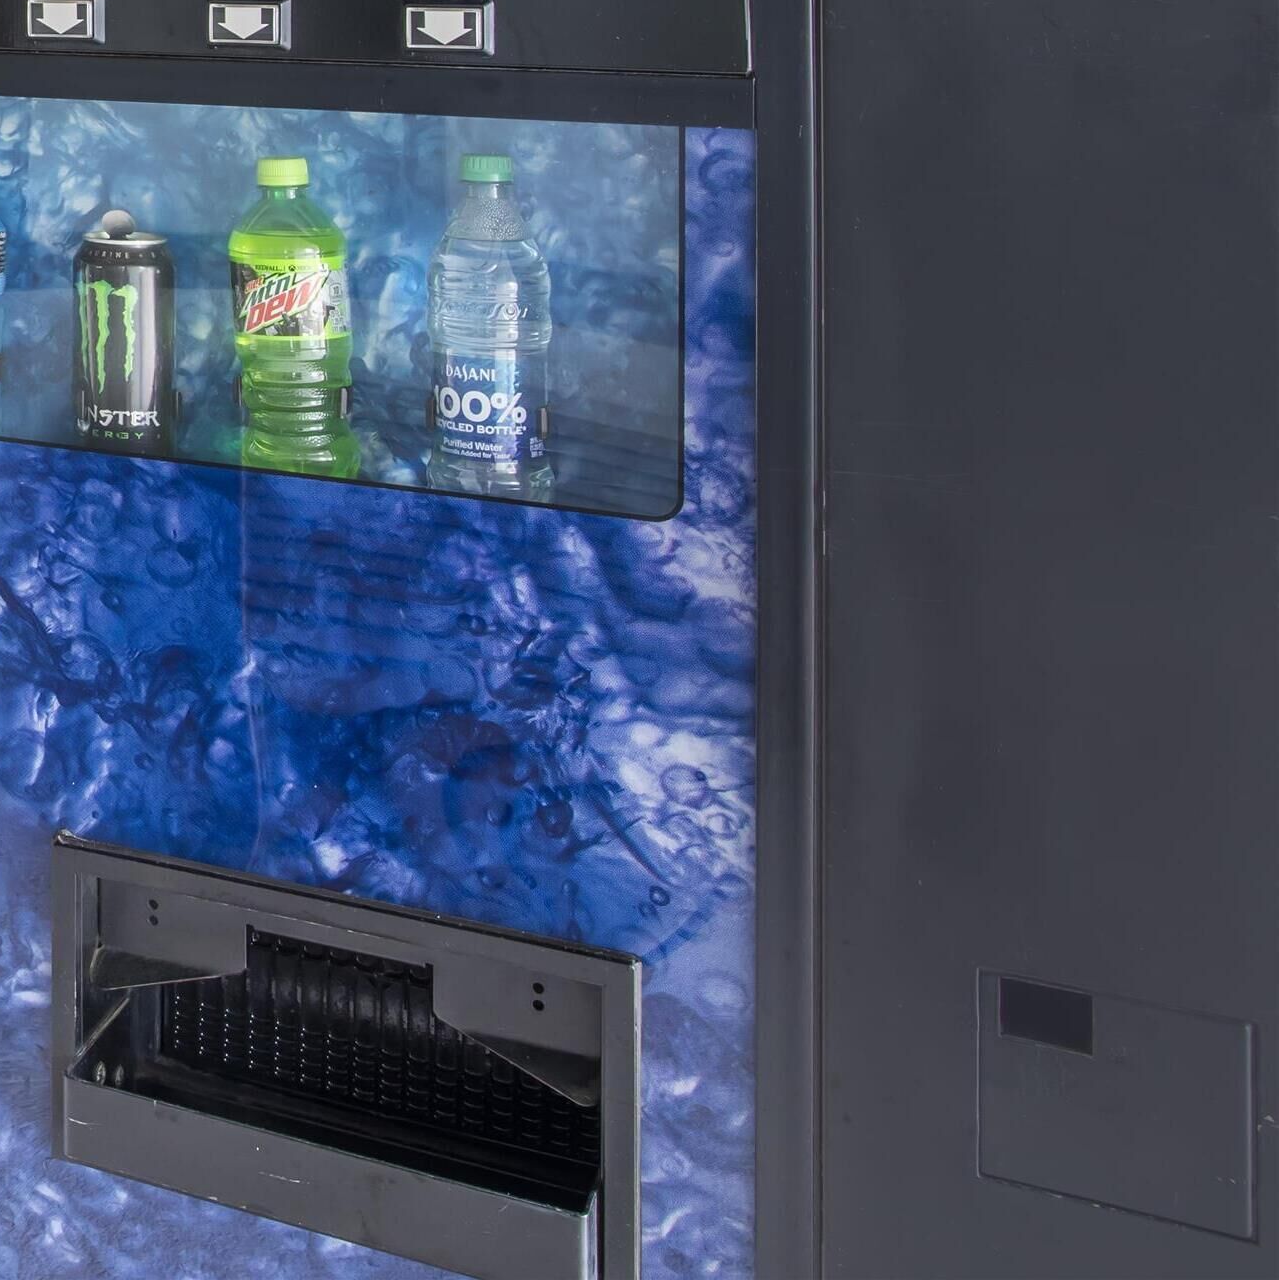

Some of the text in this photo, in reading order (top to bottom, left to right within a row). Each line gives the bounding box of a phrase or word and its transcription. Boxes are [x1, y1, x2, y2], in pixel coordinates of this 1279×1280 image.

[446, 364, 496, 382] DASANI
[434, 385, 526, 424] 100%
[443, 437, 503, 452] Purified Water
